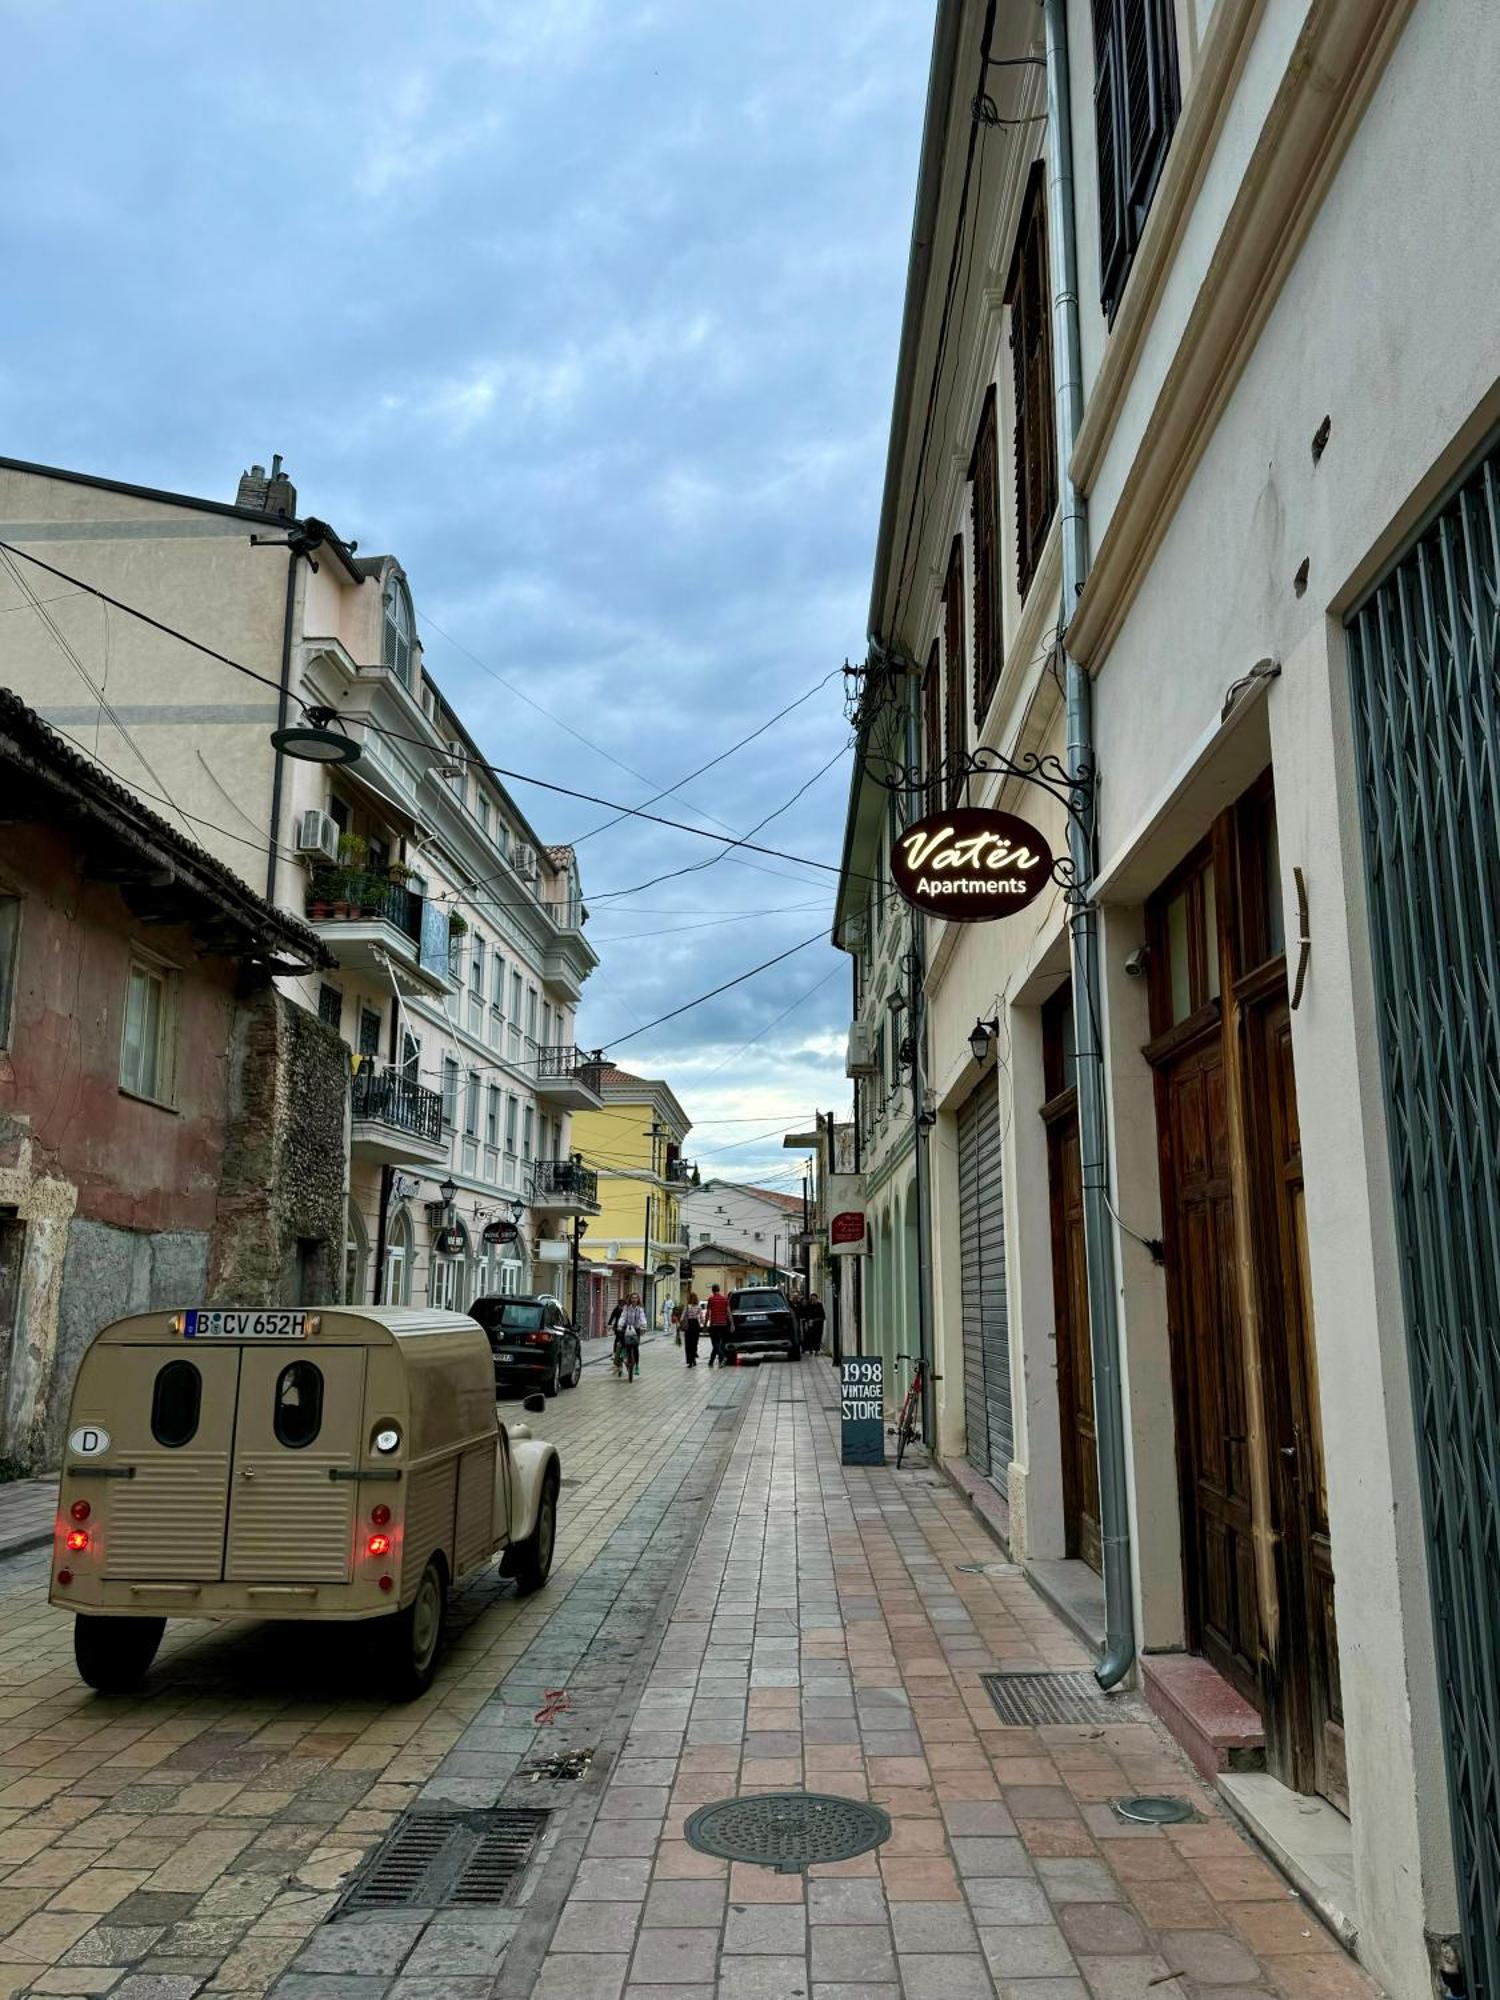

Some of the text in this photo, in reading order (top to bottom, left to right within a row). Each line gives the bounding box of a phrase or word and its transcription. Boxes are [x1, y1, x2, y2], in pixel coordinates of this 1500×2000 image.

[902, 827, 1040, 870] Vatër
[916, 877, 1027, 897] Apartments
[197, 1314, 306, 1335] B CV 652H
[842, 1363, 882, 1382] 1998
[842, 1384, 883, 1398] VINTAGE
[842, 1401, 883, 1420] STORE
[82, 1431, 98, 1452] D
